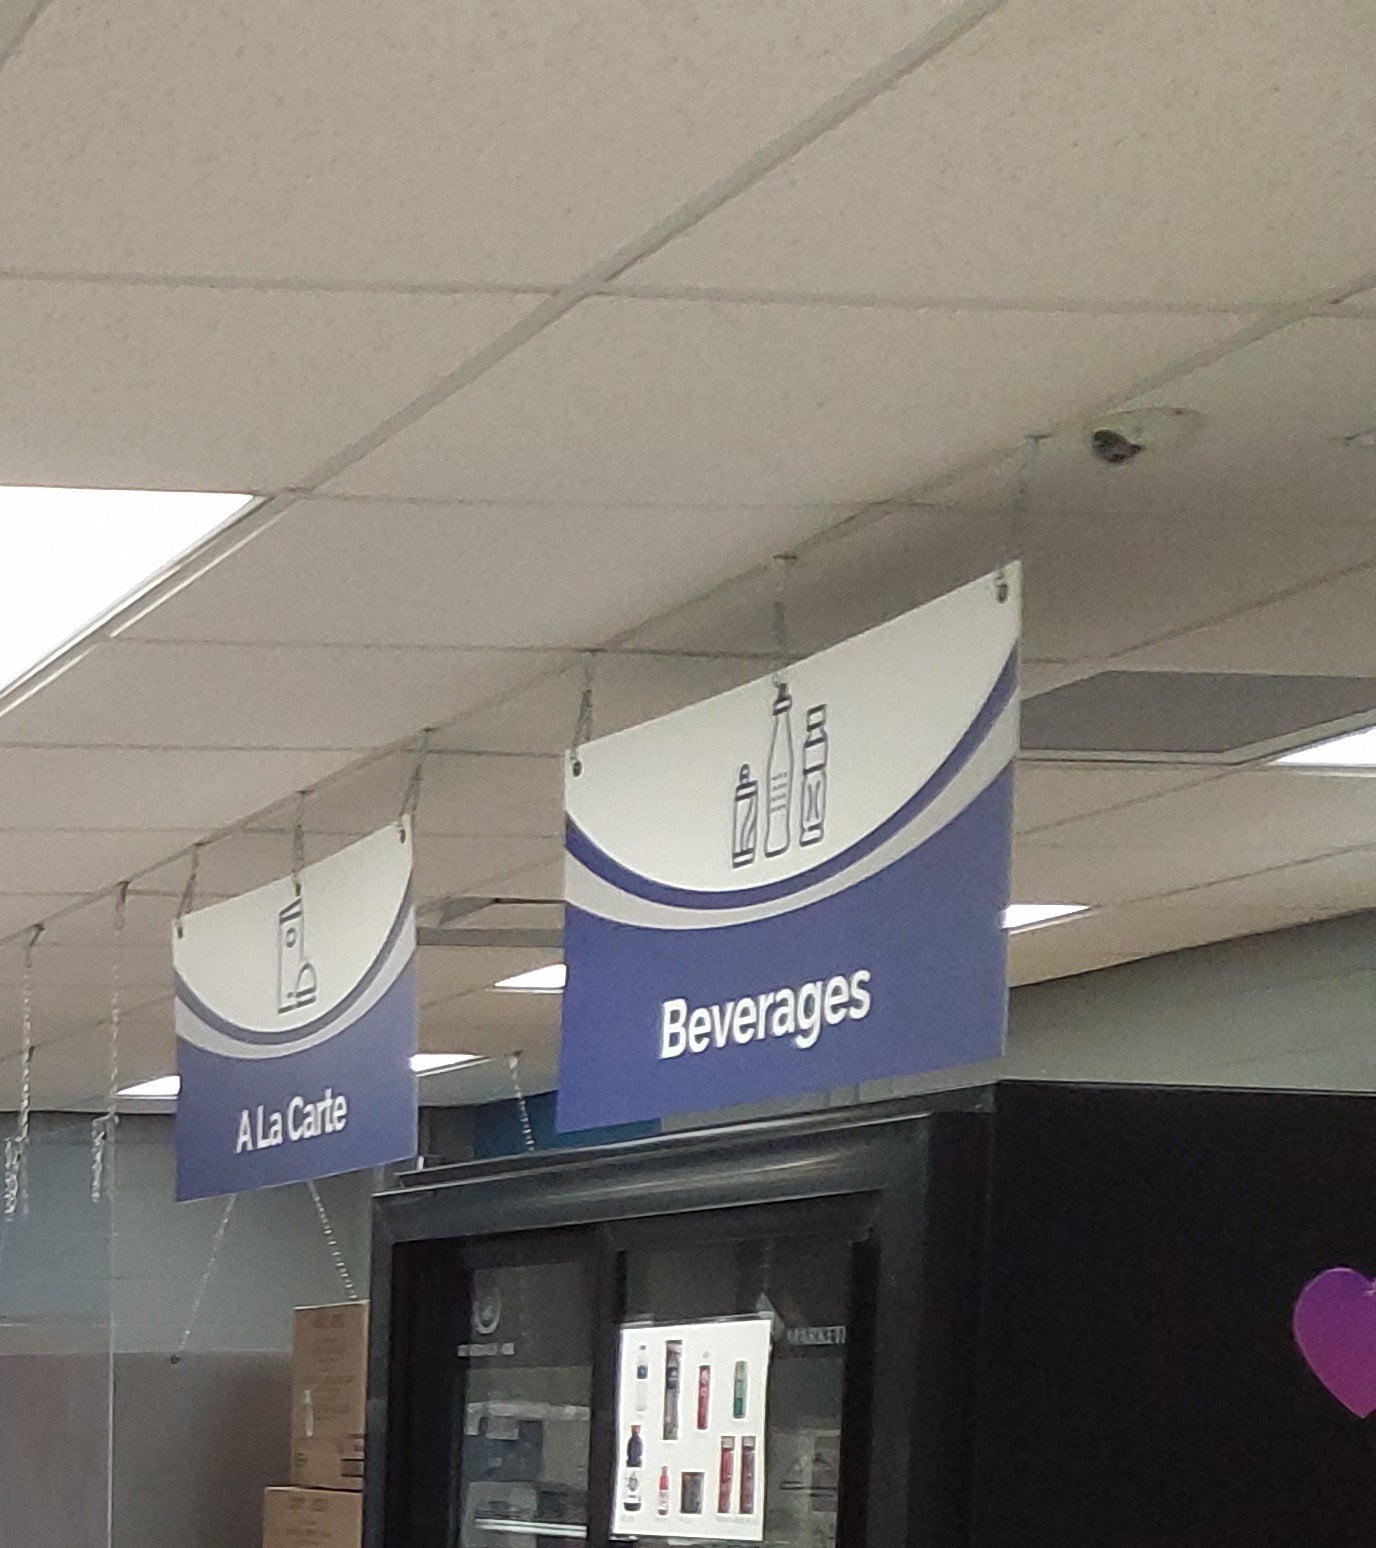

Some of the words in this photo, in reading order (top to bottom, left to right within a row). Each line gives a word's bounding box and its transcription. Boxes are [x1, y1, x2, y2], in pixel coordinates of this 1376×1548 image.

[659, 969, 871, 1060] Beverages
[236, 1108, 254, 1154] A
[256, 1104, 283, 1149] La
[287, 1087, 348, 1141] Carte
